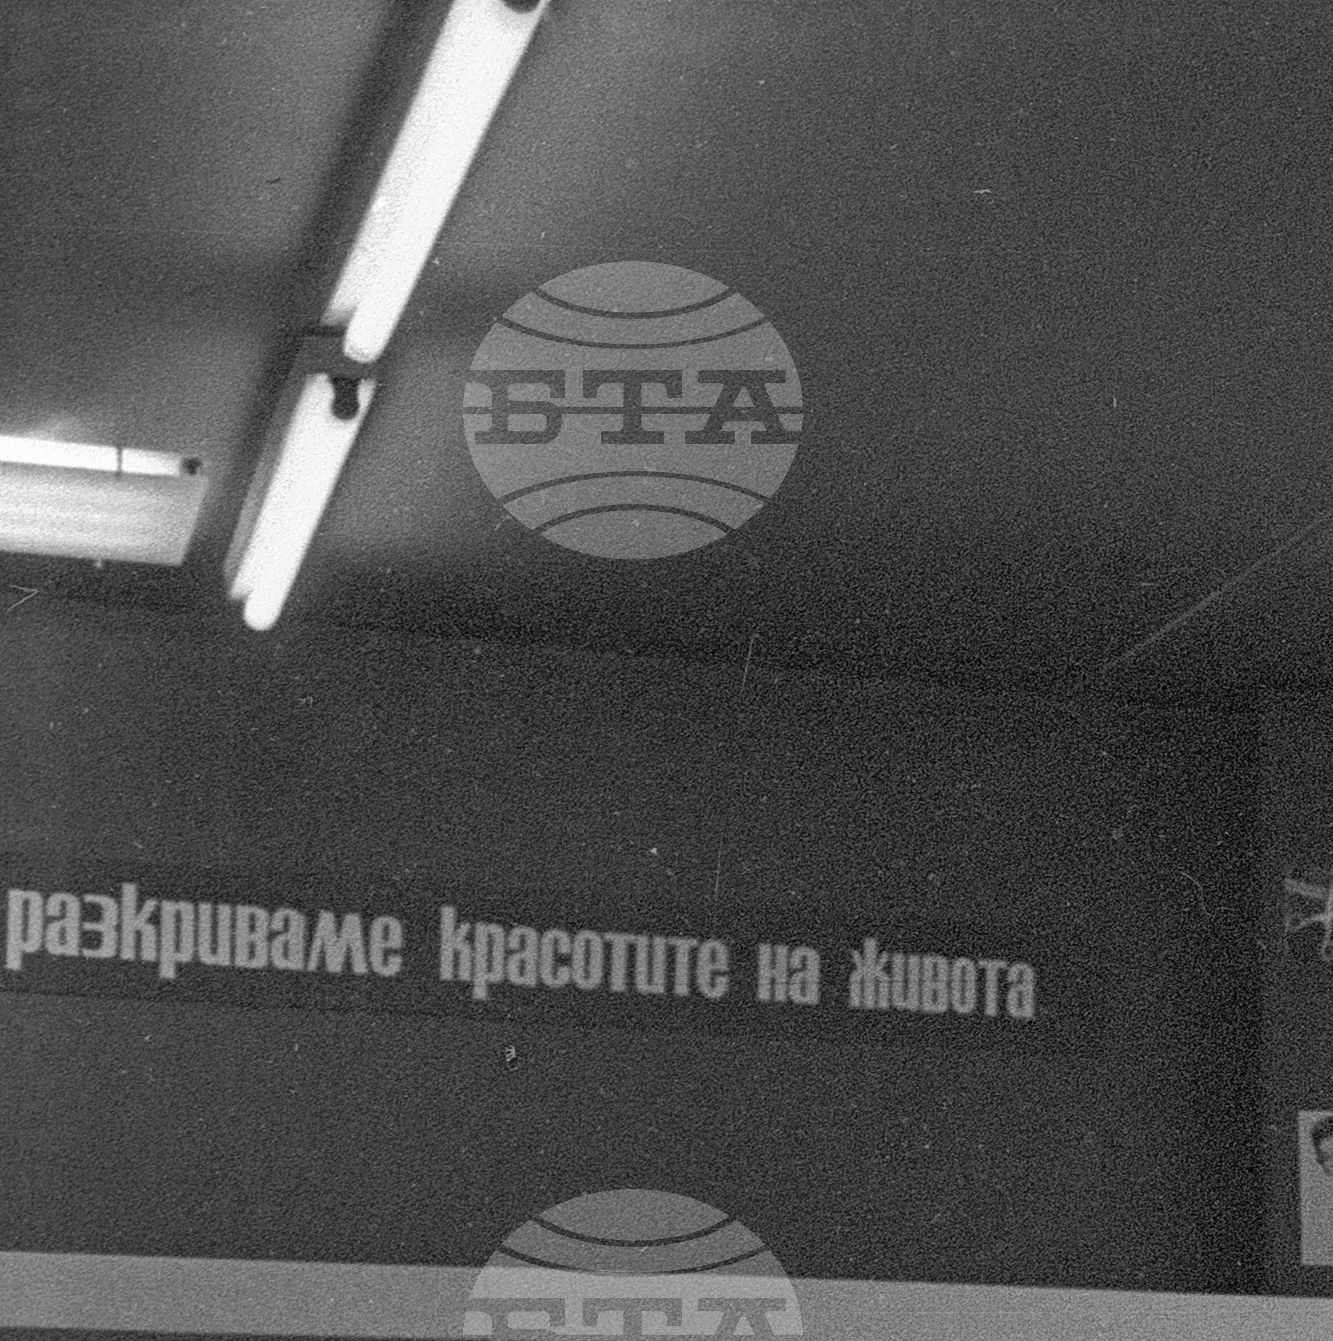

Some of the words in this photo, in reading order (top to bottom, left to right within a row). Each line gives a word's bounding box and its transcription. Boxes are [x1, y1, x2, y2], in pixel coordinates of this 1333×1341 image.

[6, 882, 401, 979] разкриваме
[440, 906, 729, 1000] красотите
[758, 942, 821, 1005] на
[849, 937, 1034, 1019] живота
